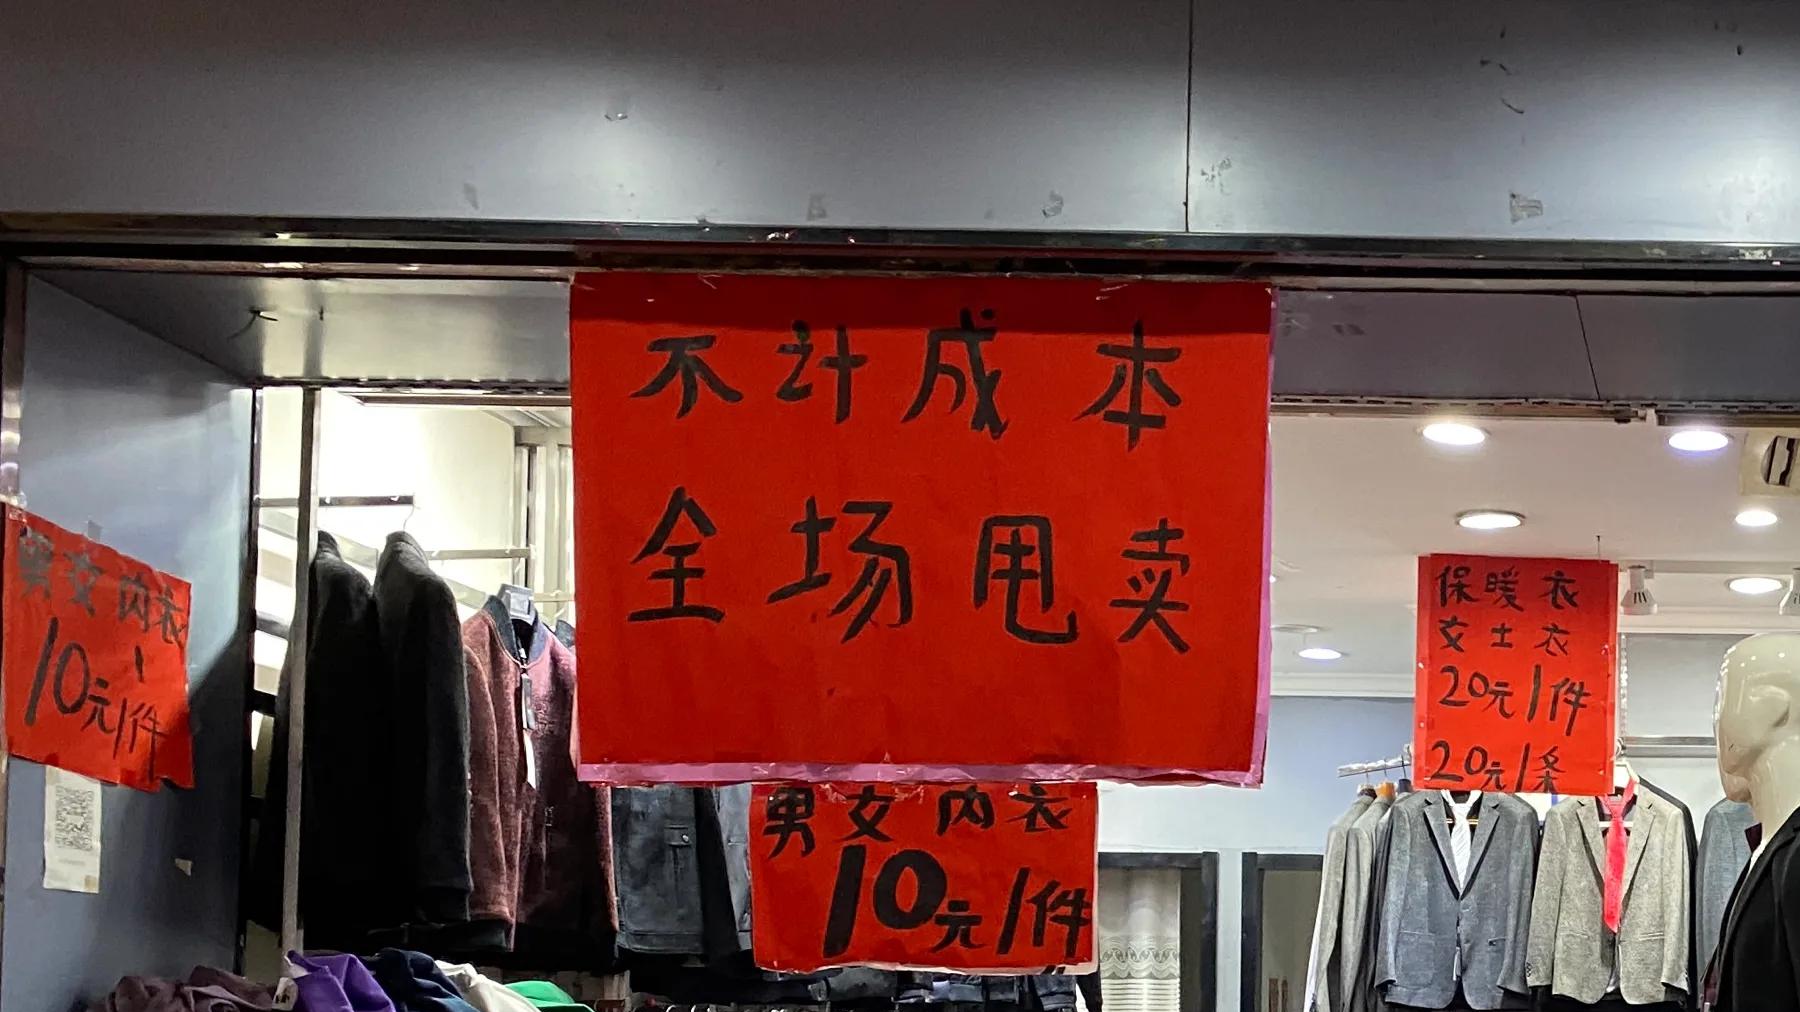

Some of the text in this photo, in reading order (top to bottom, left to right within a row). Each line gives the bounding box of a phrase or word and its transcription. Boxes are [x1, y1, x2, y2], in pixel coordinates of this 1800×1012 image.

[630, 308, 1181, 452] 不计成本
[628, 485, 1192, 654] 全场甩卖
[1435, 566, 1580, 612] 保暖衣
[1439, 615, 1570, 656] 女士衣
[763, 785, 1071, 859] 男女内衣
